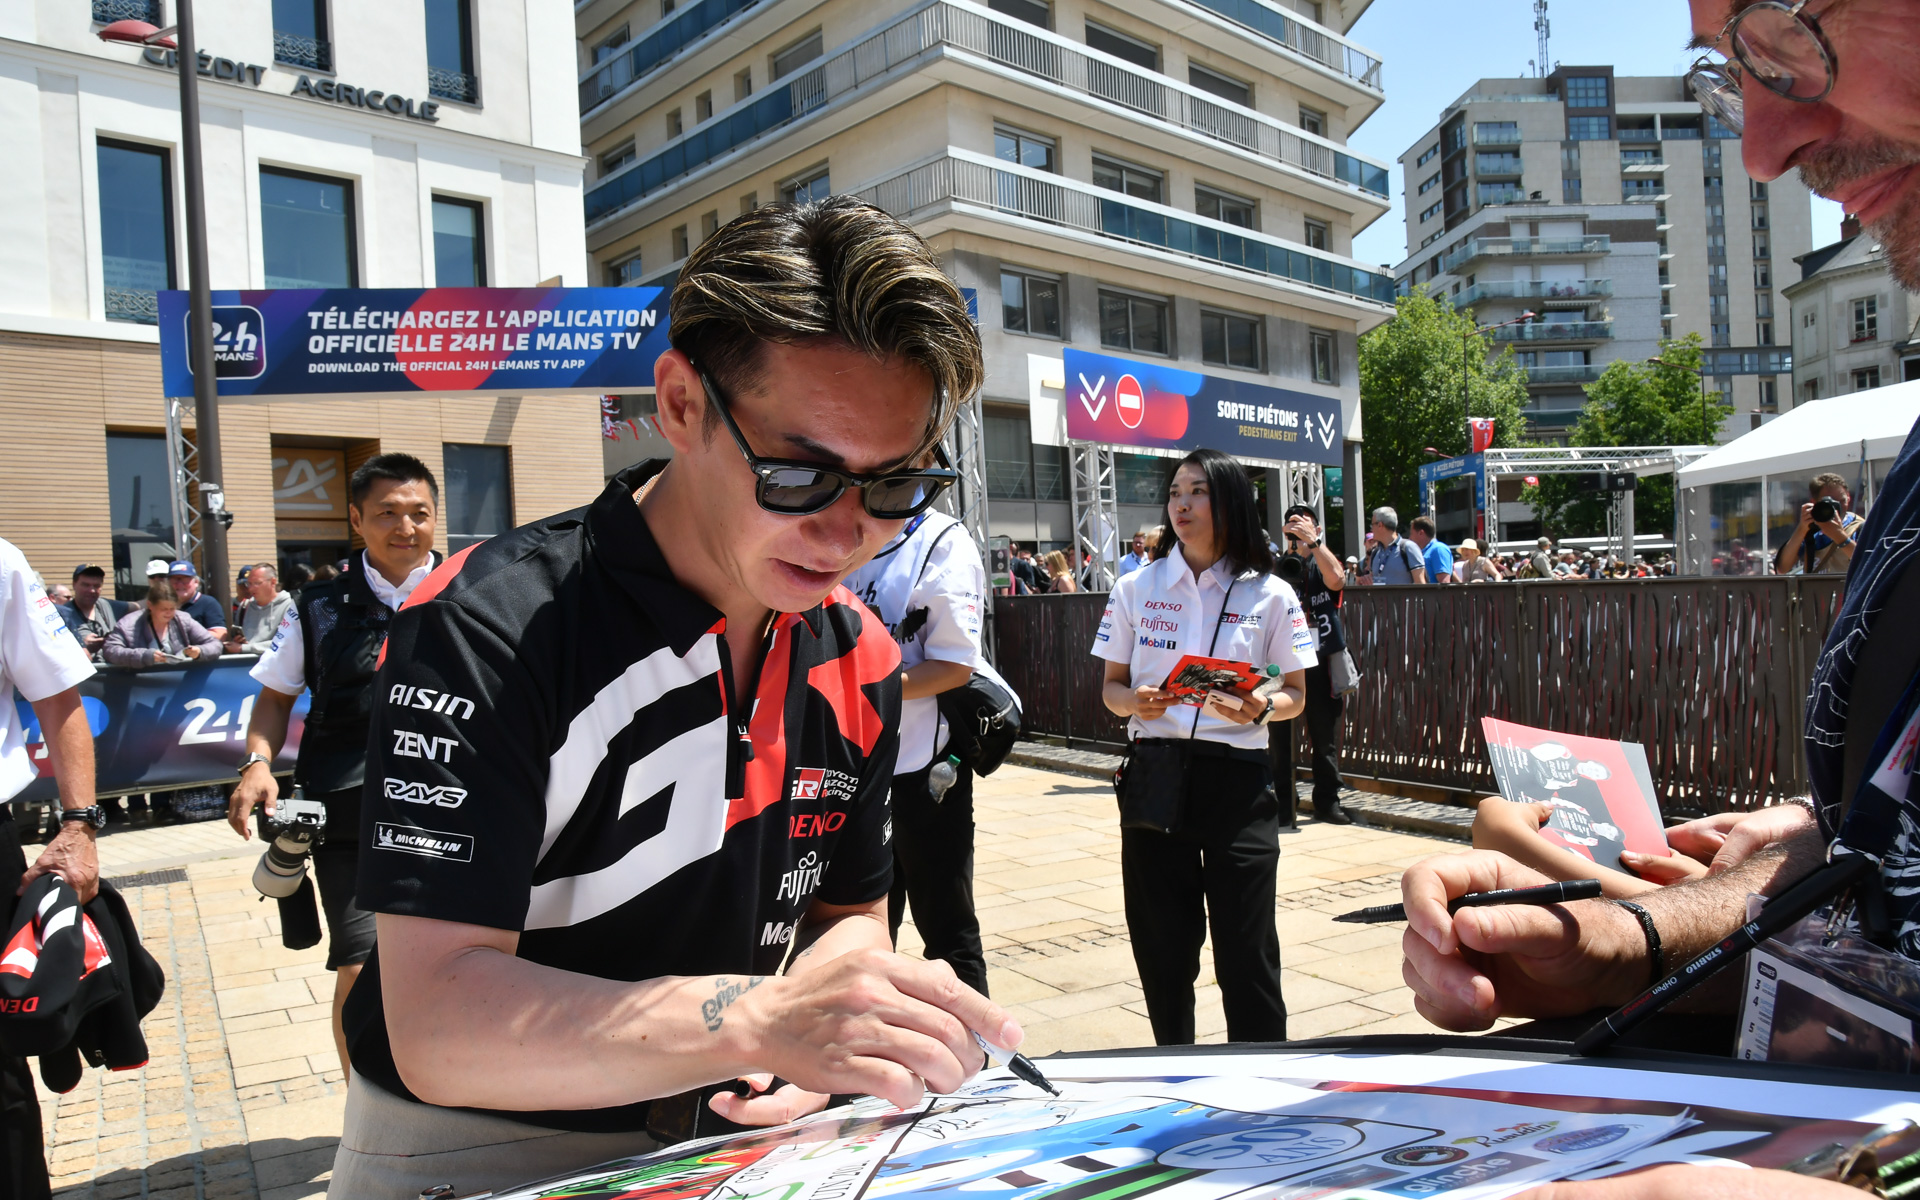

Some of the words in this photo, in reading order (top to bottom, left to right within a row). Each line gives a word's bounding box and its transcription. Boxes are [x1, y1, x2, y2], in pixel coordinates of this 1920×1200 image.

[291, 75, 440, 121] AGRICOLE
[308, 306, 480, 330] TÉLÉCHARGEZ
[485, 308, 657, 329] L'APPLICATION
[308, 333, 443, 354] OFFICIELLE
[449, 333, 496, 352] 24H
[502, 332, 529, 352] LE
[536, 332, 603, 351] MANS
[611, 331, 642, 350] TV
[308, 362, 380, 374] DOWNLOAD
[382, 361, 407, 373] THE
[409, 360, 463, 372] OFFICIAL
[465, 360, 489, 371] 24H
[491, 359, 540, 371] LEMANS
[543, 359, 559, 370] TV
[561, 359, 586, 370] APP
[1217, 400, 1256, 422] SORTIE
[1257, 403, 1298, 428] PIÉTONS
[1238, 425, 1283, 440] PEDESTRIANS
[1283, 431, 1298, 442] EXIT
[1144, 600, 1182, 612] DENSO
[1140, 616, 1178, 632] FUJITSU
[1139, 636, 1166, 648] Mobil
[393, 729, 459, 763] ZENT
[384, 777, 468, 809] RAYS
[395, 833, 462, 853] MICHELIN
[1748, 922, 1760, 935] M
[1685, 947, 1722, 974] STABILO
[1652, 976, 1678, 996] OHPen
[1754, 979, 1761, 990] 3
[1622, 993, 1653, 1017] universal
[1753, 996, 1760, 1007] 4
[1748, 1022, 1755, 1033] 5
[1744, 1049, 1752, 1060] 6
[1177, 1127, 1312, 1160] 50
[1255, 1136, 1347, 1164] ANS
[1403, 1157, 1512, 1193] glinche
